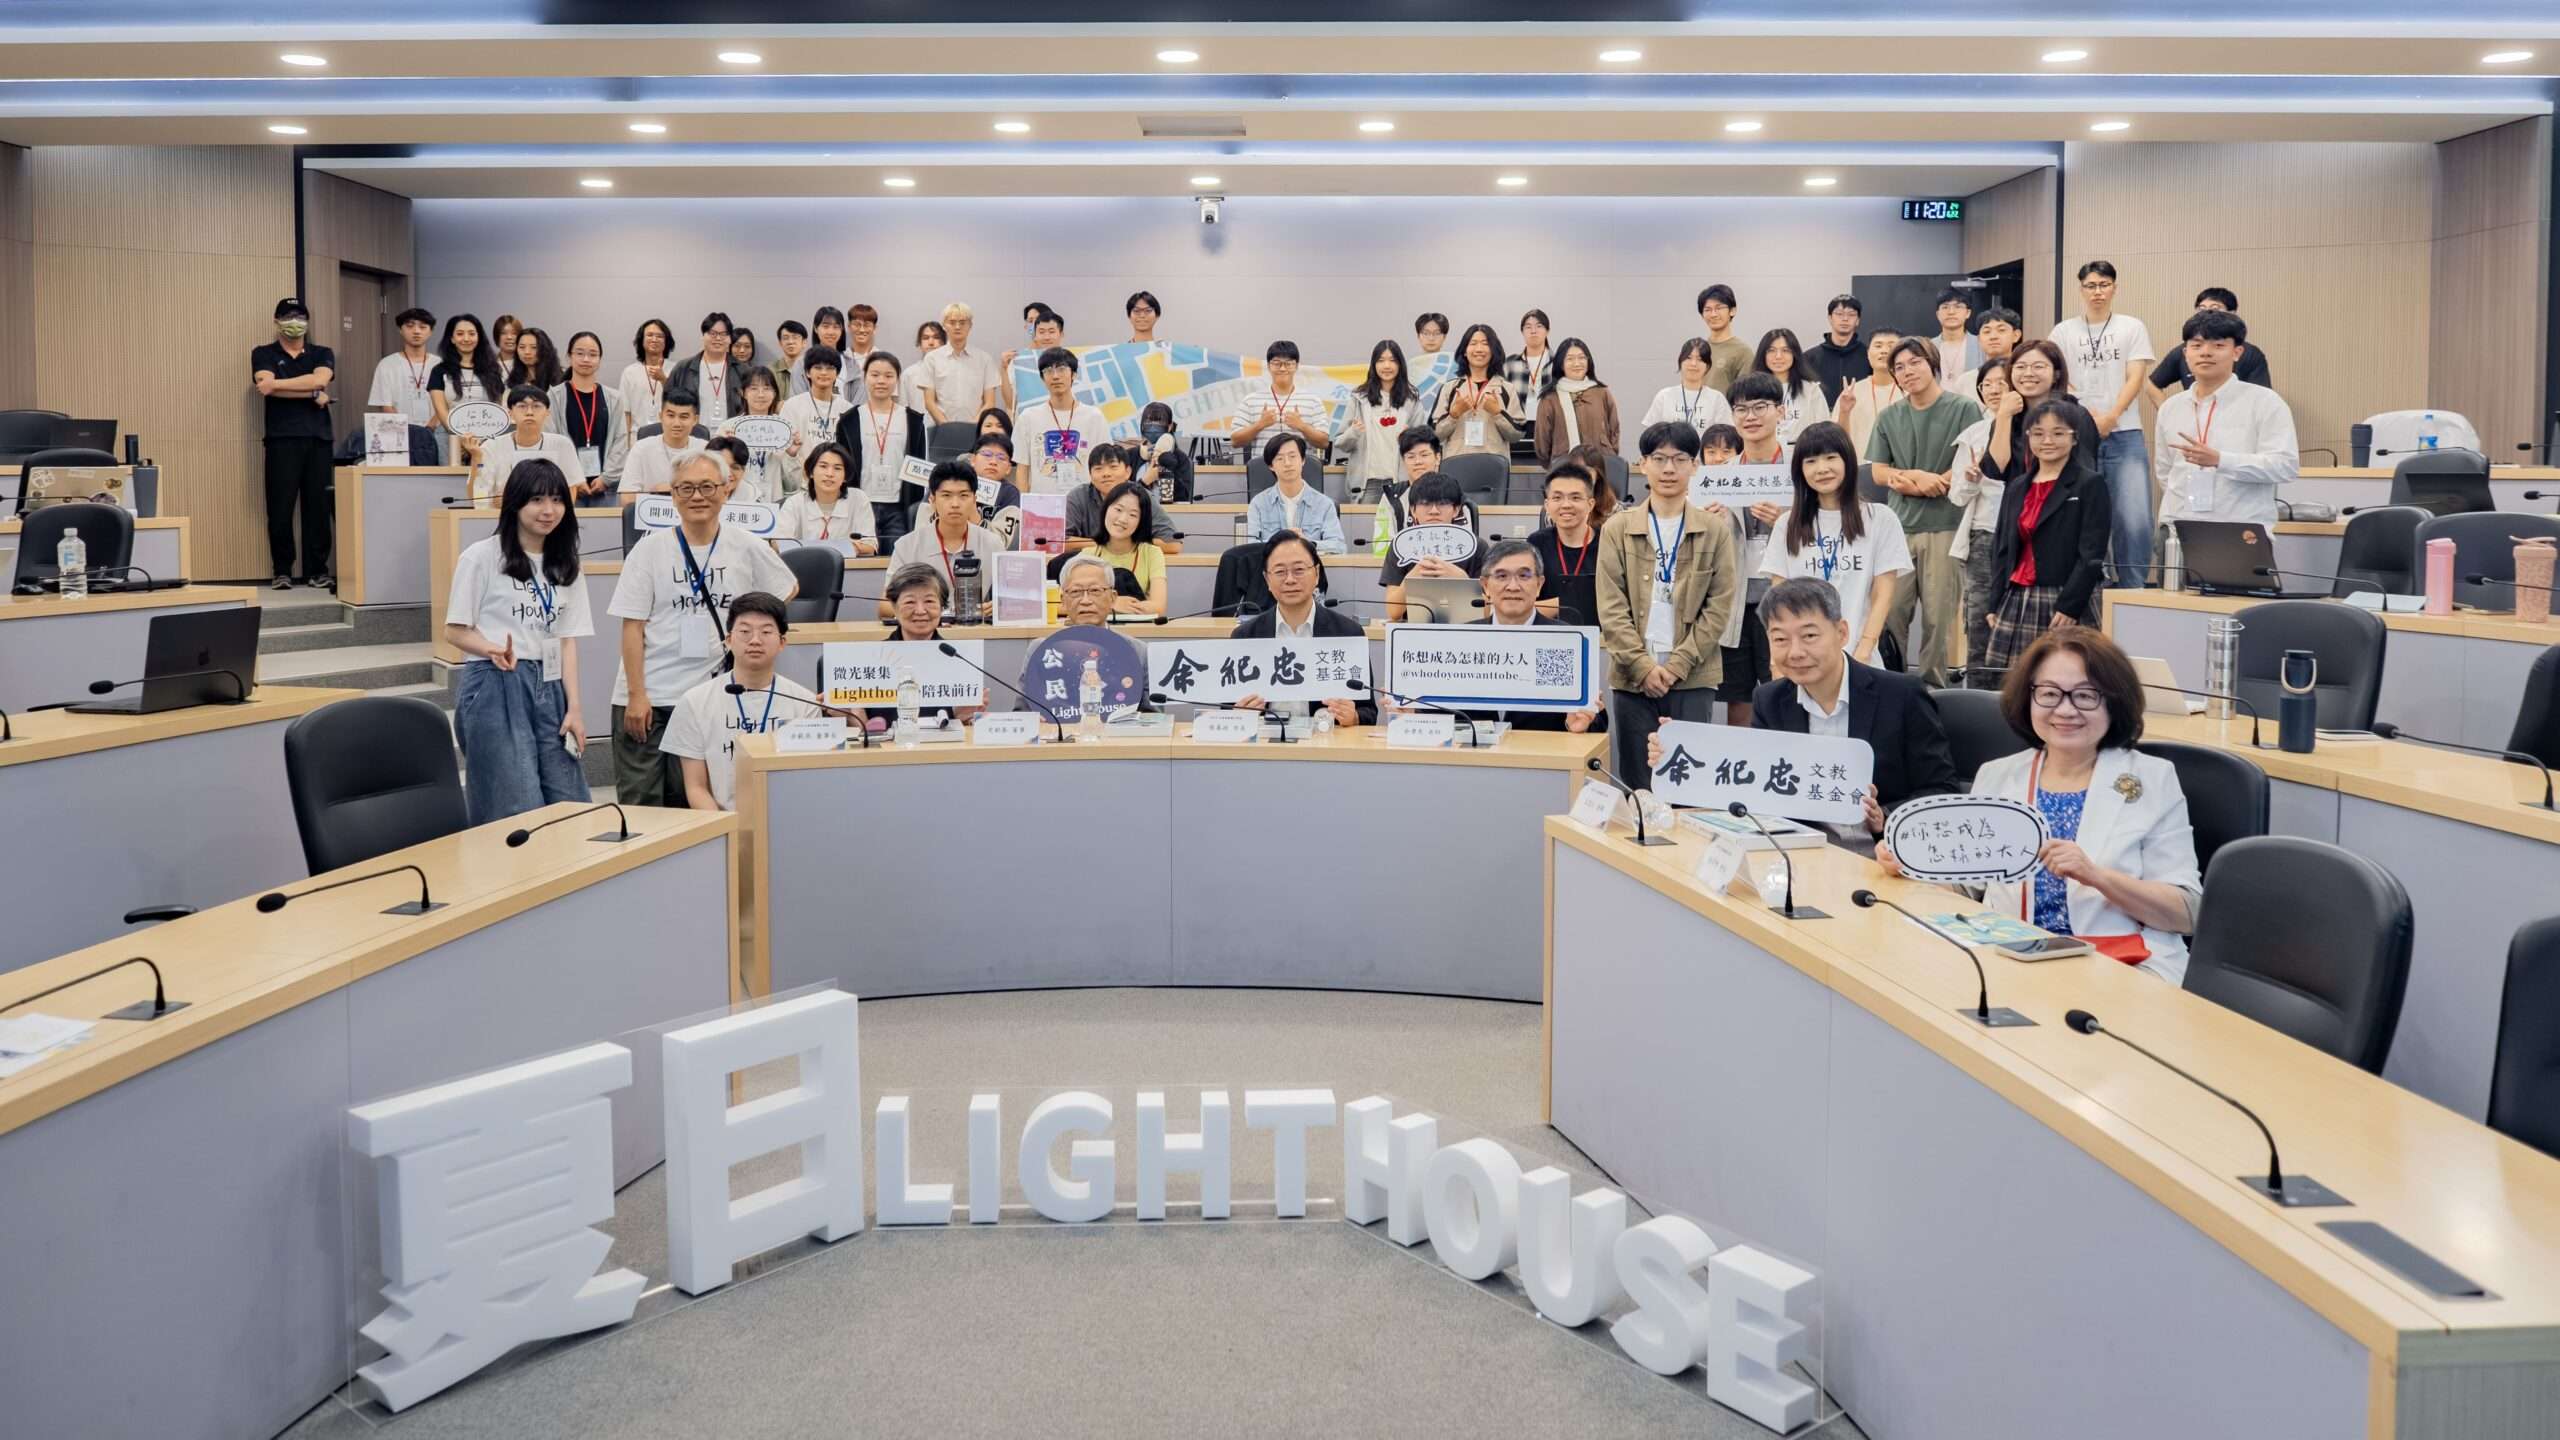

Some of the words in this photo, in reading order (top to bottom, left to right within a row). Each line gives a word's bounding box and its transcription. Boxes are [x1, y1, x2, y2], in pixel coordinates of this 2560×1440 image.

[1315, 649, 1347, 665] 文教
[1402, 650, 1529, 666] 你想成為怎樣的大人
[833, 666, 892, 681] 微光聚集
[1042, 648, 1068, 700] 公民
[1158, 646, 1305, 694] 余紀忠
[1315, 664, 1363, 682] 基金會
[833, 685, 899, 702] Lightho
[1655, 743, 1801, 796] 余紀忠
[1809, 762, 1848, 781] 文教
[1807, 783, 1865, 805] 基金會
